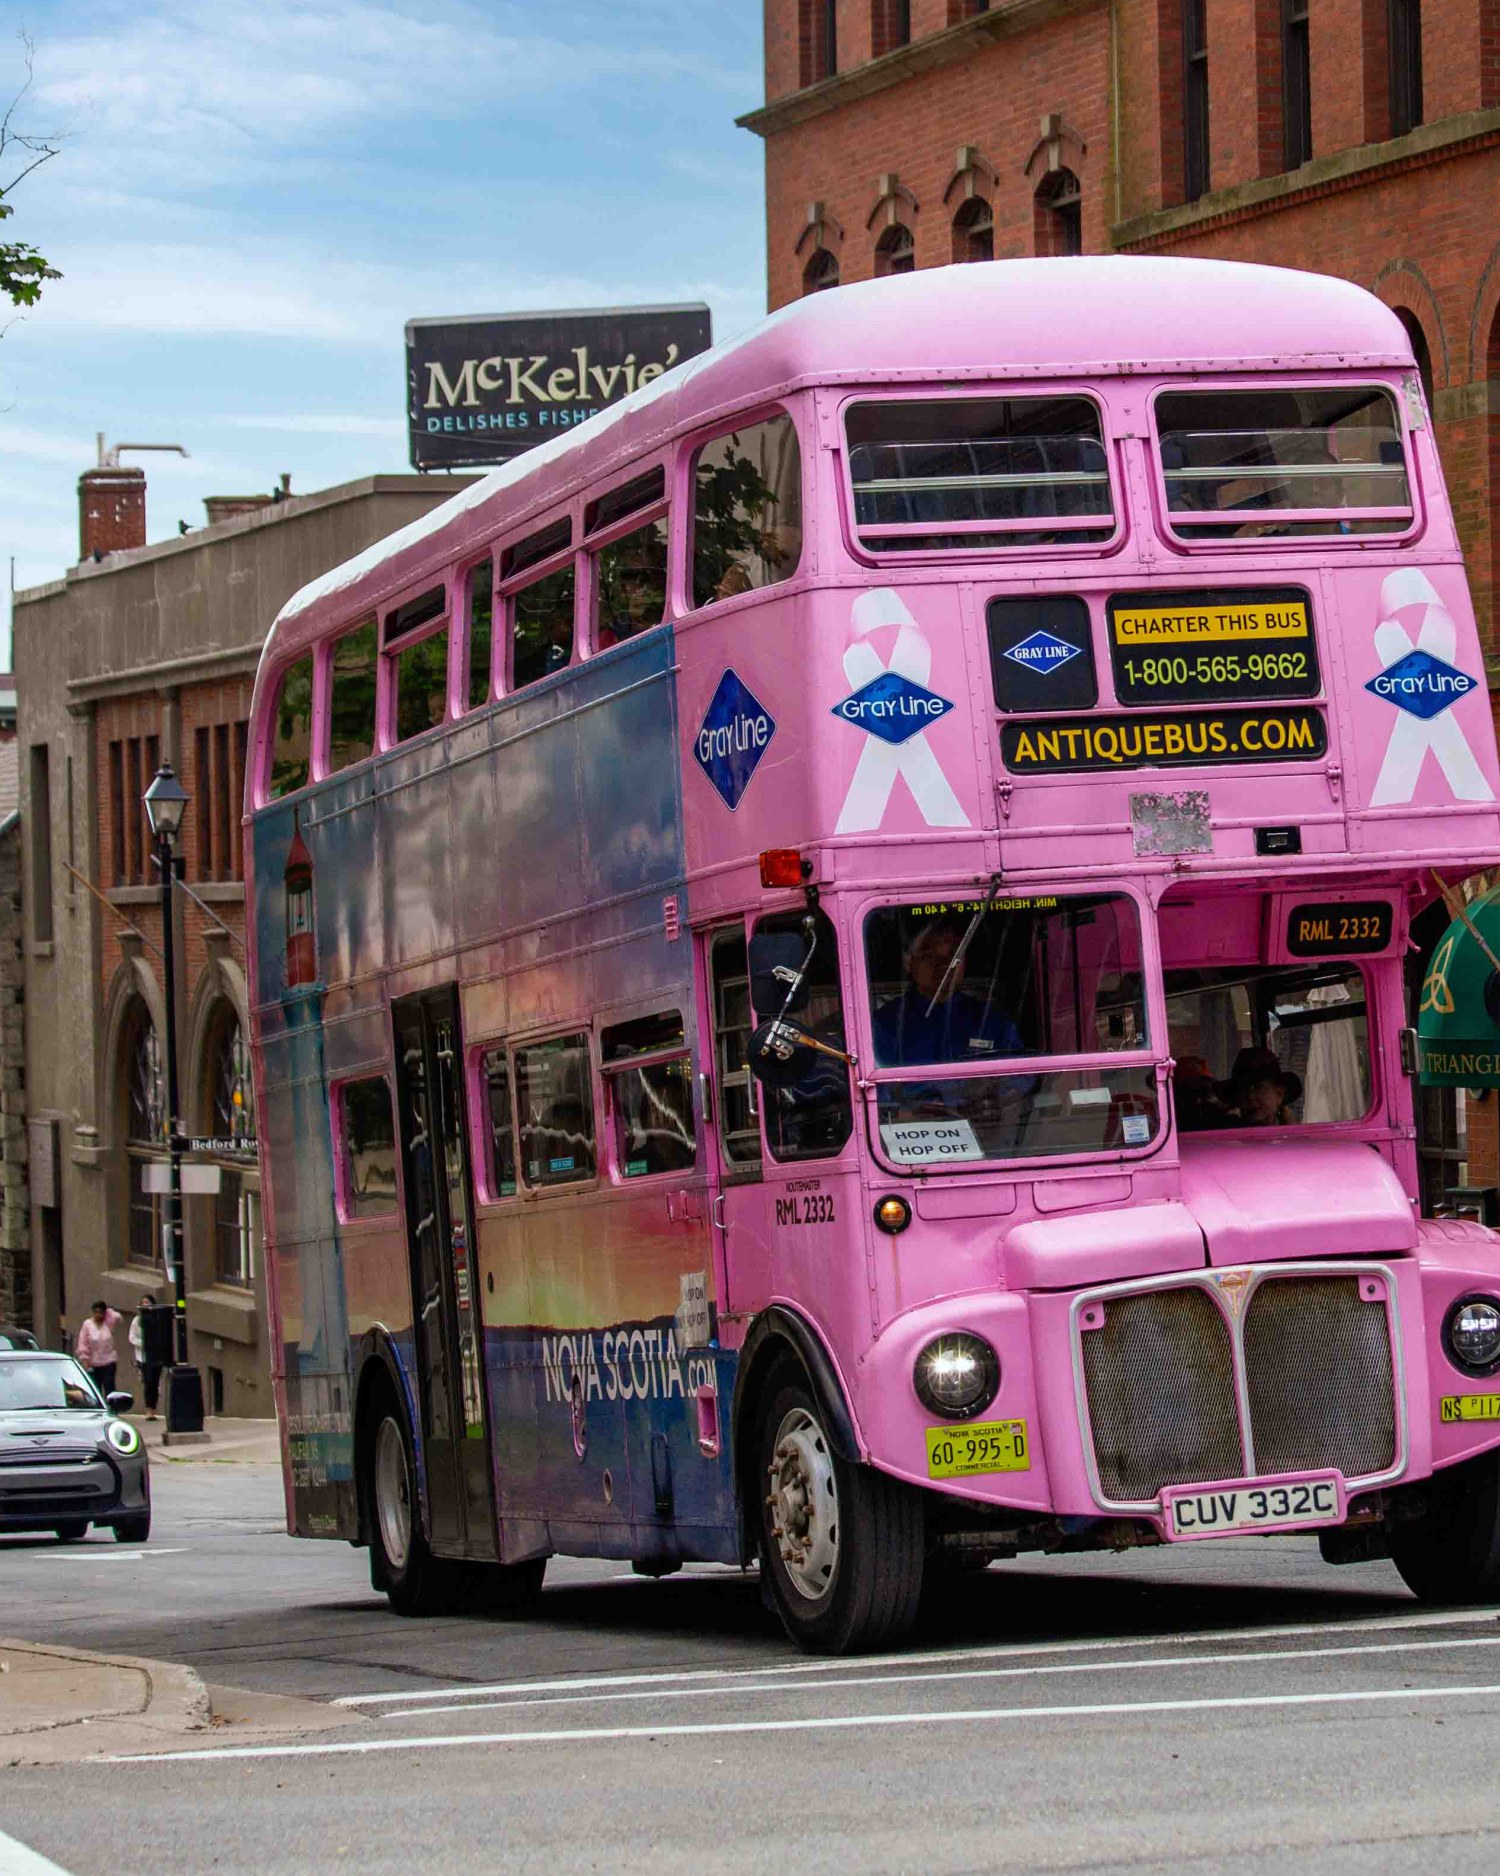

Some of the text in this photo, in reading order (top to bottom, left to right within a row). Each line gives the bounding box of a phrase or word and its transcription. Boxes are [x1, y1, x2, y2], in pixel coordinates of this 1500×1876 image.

[422, 343, 679, 409] McKelvie'
[426, 412, 528, 433] DELISHES
[1121, 611, 1302, 636] CHARTER THIS BUS
[1014, 645, 1070, 660] GRAY LINE
[1123, 651, 1309, 686] 1-800-565-9662
[1014, 717, 1315, 763] ANTIQUEBUS.COM
[1299, 916, 1381, 942] RML 2332
[192, 1139, 235, 1150] Bedford
[894, 1129, 961, 1140] HOP ON
[899, 1143, 970, 1156] HOP OFF
[775, 1195, 835, 1226] RML 2332
[1444, 1399, 1461, 1418] NS
[973, 1427, 1003, 1437] SCOTIA
[955, 1461, 1003, 1472] COMMERCIAL
[1175, 1484, 1333, 1527] CUV 332C
